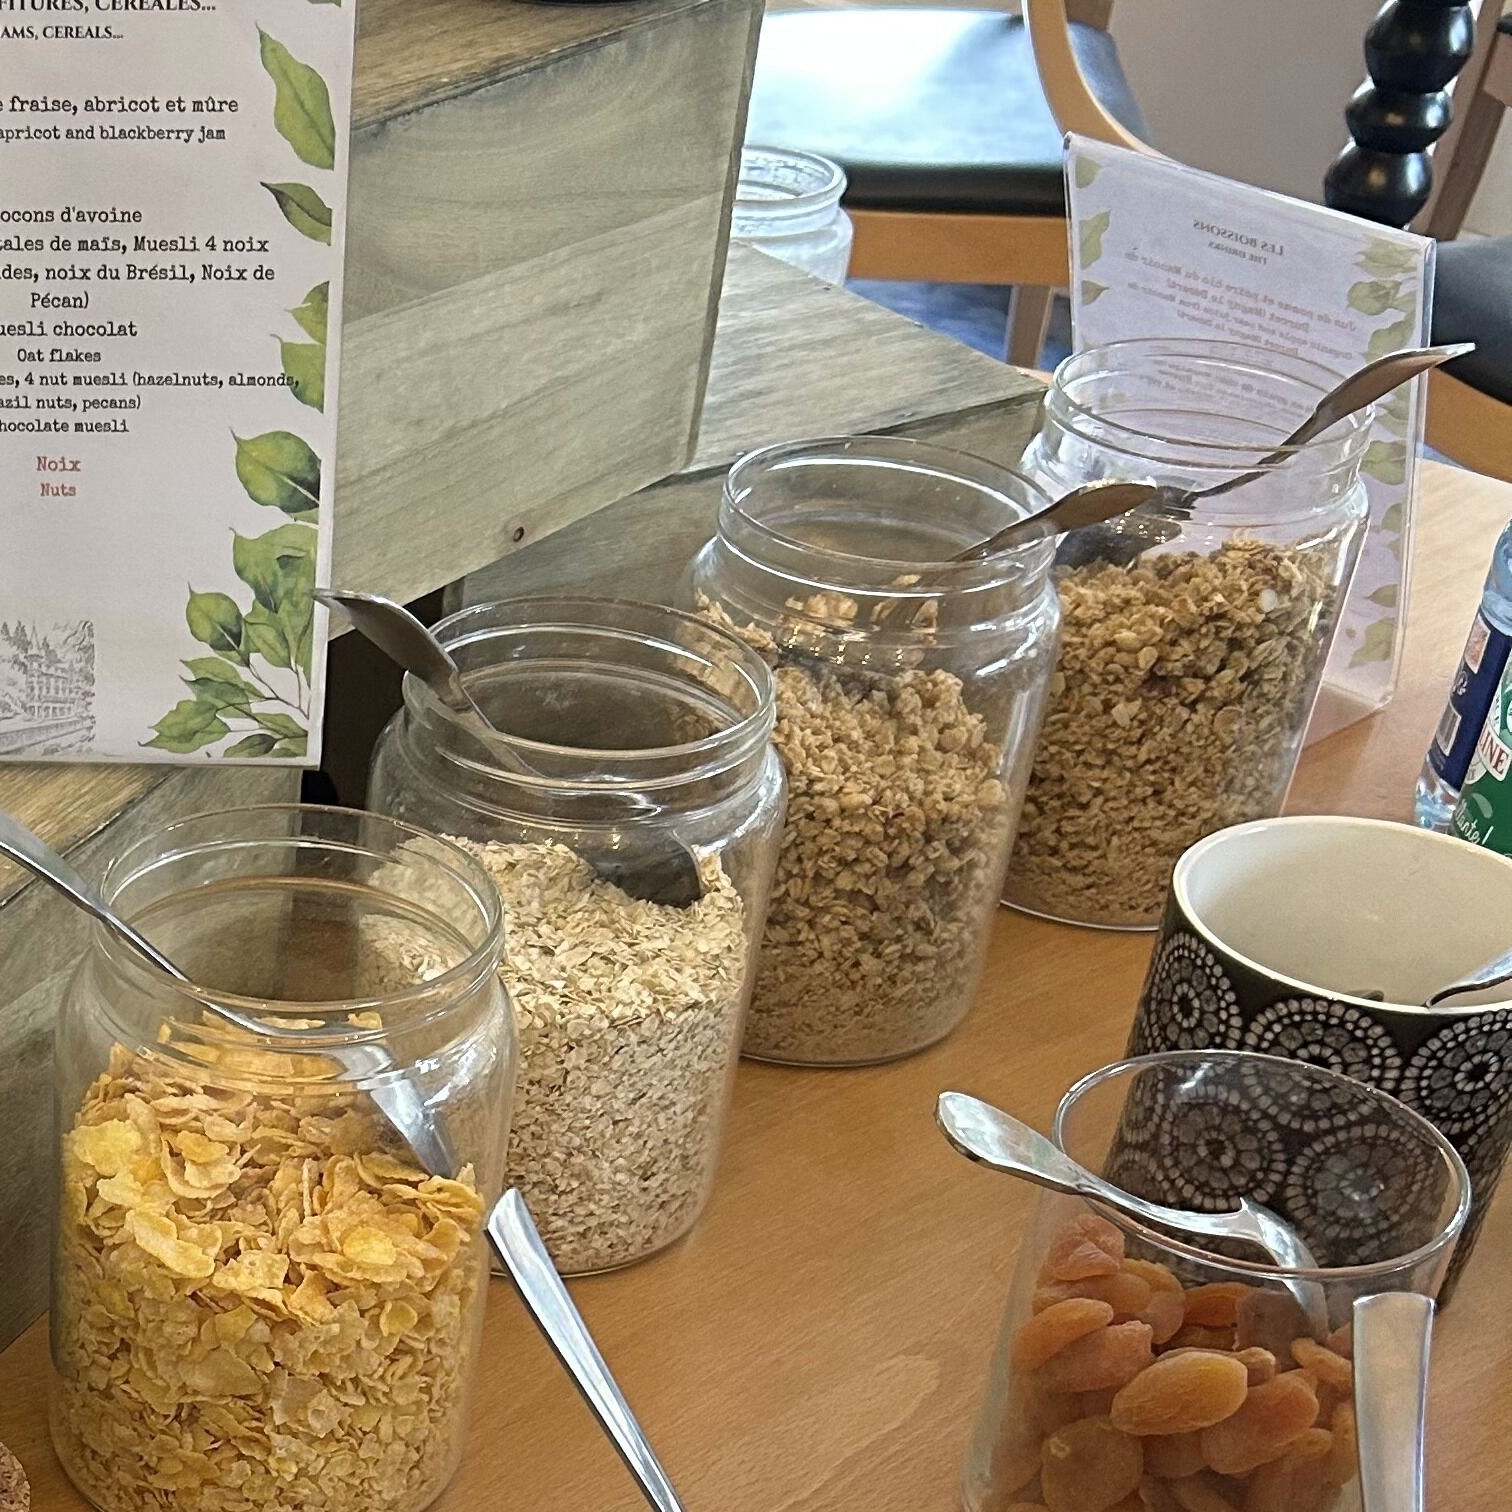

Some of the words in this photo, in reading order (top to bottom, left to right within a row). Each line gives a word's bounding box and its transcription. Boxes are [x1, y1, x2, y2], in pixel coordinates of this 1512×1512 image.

[42, 25, 124, 40] CEREALS...
[8, 94, 79, 117] fraise,
[83, 95, 161, 114] abricot
[165, 95, 187, 113] et
[191, 95, 239, 113] mûre
[65, 124, 96, 140] and
[98, 124, 195, 144] blackberry
[197, 125, 226, 144] jam
[60, 205, 143, 224] d'avoine
[49, 234, 72, 252] de
[77, 236, 128, 256] maïs,
[132, 234, 201, 253] Muesli
[204, 234, 218, 252] 4
[222, 235, 270, 253] noix
[44, 263, 92, 281] noix
[96, 263, 121, 281] du
[125, 263, 196, 284] Brésil,
[200, 263, 248, 282] Noix
[252, 264, 275, 281] de
[30, 290, 90, 310] Pécan)
[52, 320, 138, 337] chocolat
[16, 347, 45, 363] Oat
[48, 347, 102, 363] flakes
[23, 371, 35, 386] 4
[38, 371, 69, 387] nut
[72, 371, 129, 387] muesli
[132, 370, 224, 390] (hazelnuts,
[228, 371, 300, 390] almonds,
[35, 395, 78, 413] nuts,
[81, 393, 142, 413] pecans)
[73, 418, 130, 433] muesli
[36, 455, 81, 473] Noix
[40, 482, 77, 497] Nuts
